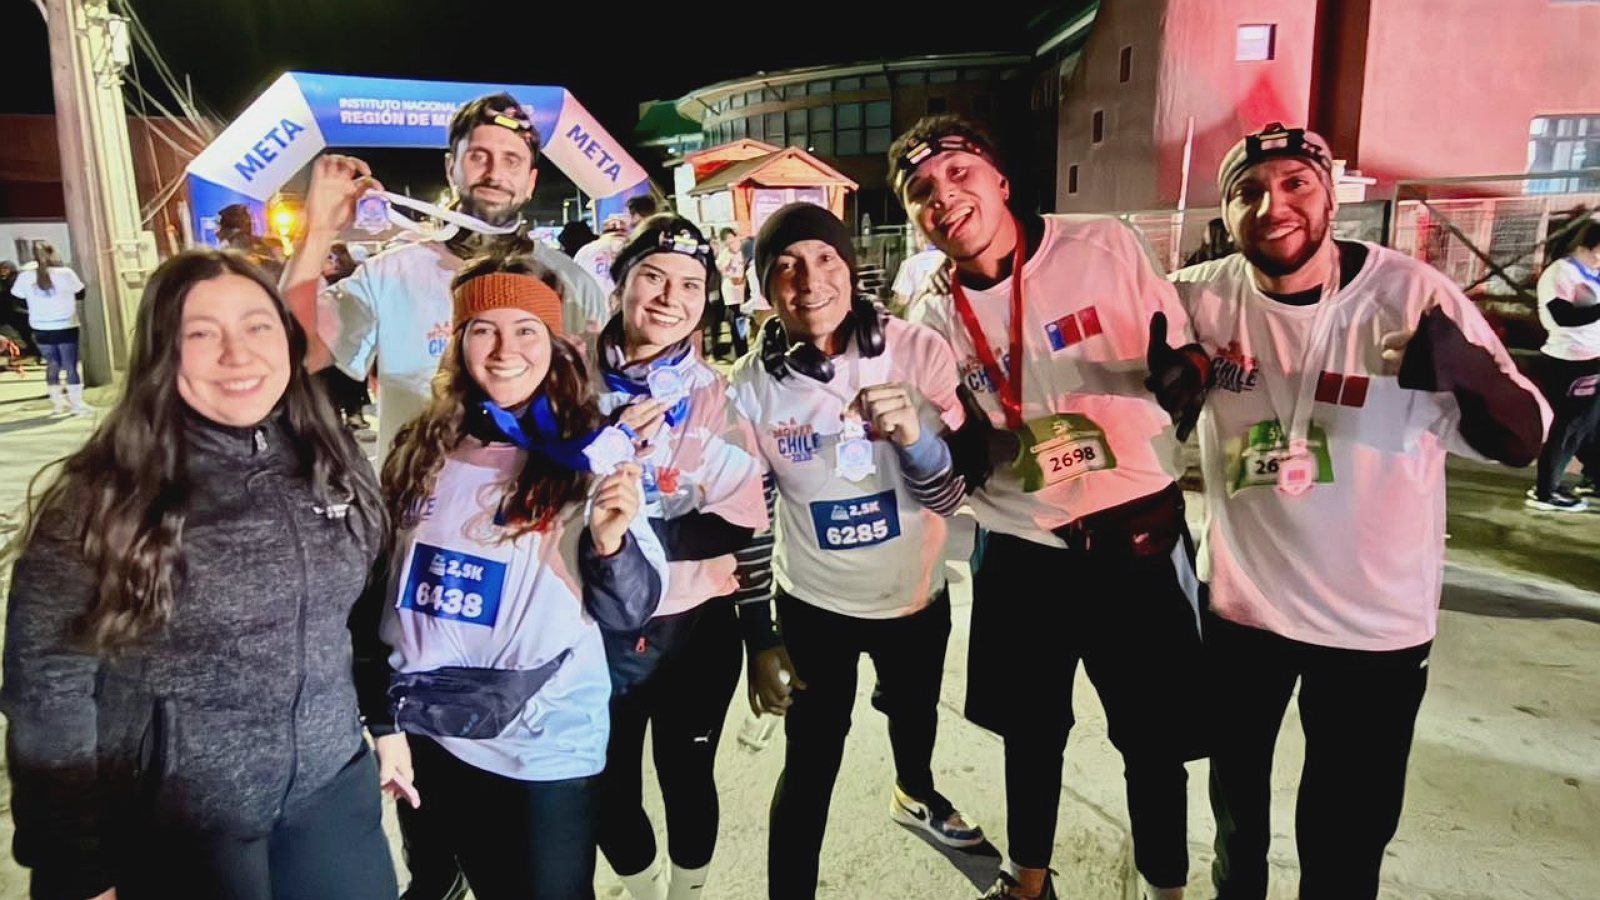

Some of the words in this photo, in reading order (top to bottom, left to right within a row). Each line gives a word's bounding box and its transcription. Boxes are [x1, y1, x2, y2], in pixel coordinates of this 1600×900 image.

[339, 98, 401, 110] INSTITUTO
[341, 110, 405, 125] REGIÓN
[407, 113, 430, 126] DE
[234, 116, 304, 182] META
[565, 124, 622, 183] META
[1049, 446, 1096, 472] 2698
[1255, 458, 1280, 475] 26
[826, 520, 888, 545] 6285
[415, 581, 484, 618] 6438
